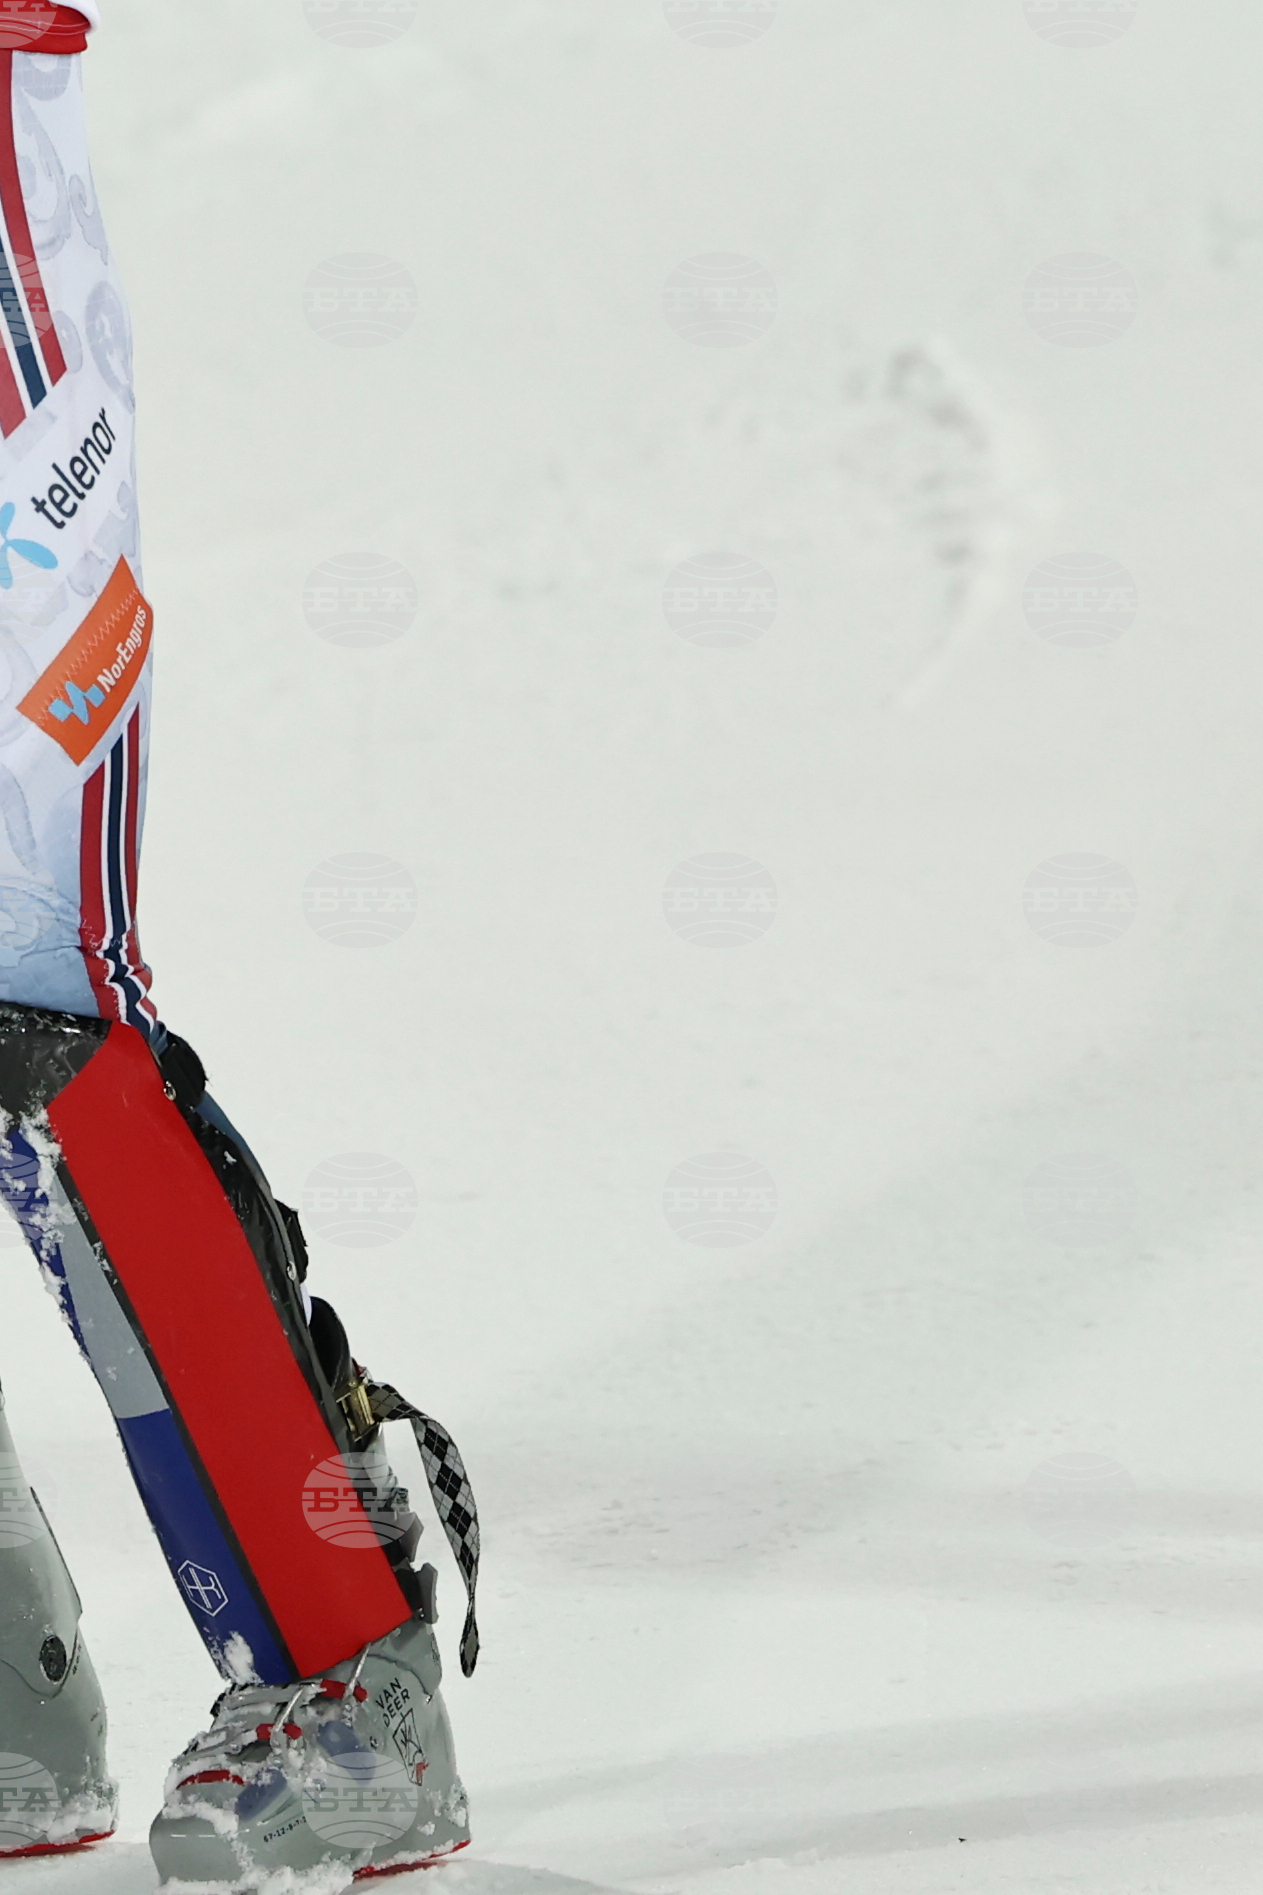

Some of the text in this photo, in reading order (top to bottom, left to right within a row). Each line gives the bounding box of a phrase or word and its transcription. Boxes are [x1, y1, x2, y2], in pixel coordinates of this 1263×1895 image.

[30, 406, 117, 531] telenor
[96, 605, 148, 693] NorEngros
[375, 1677, 402, 1710] VAN
[381, 1688, 411, 1728] DEER
